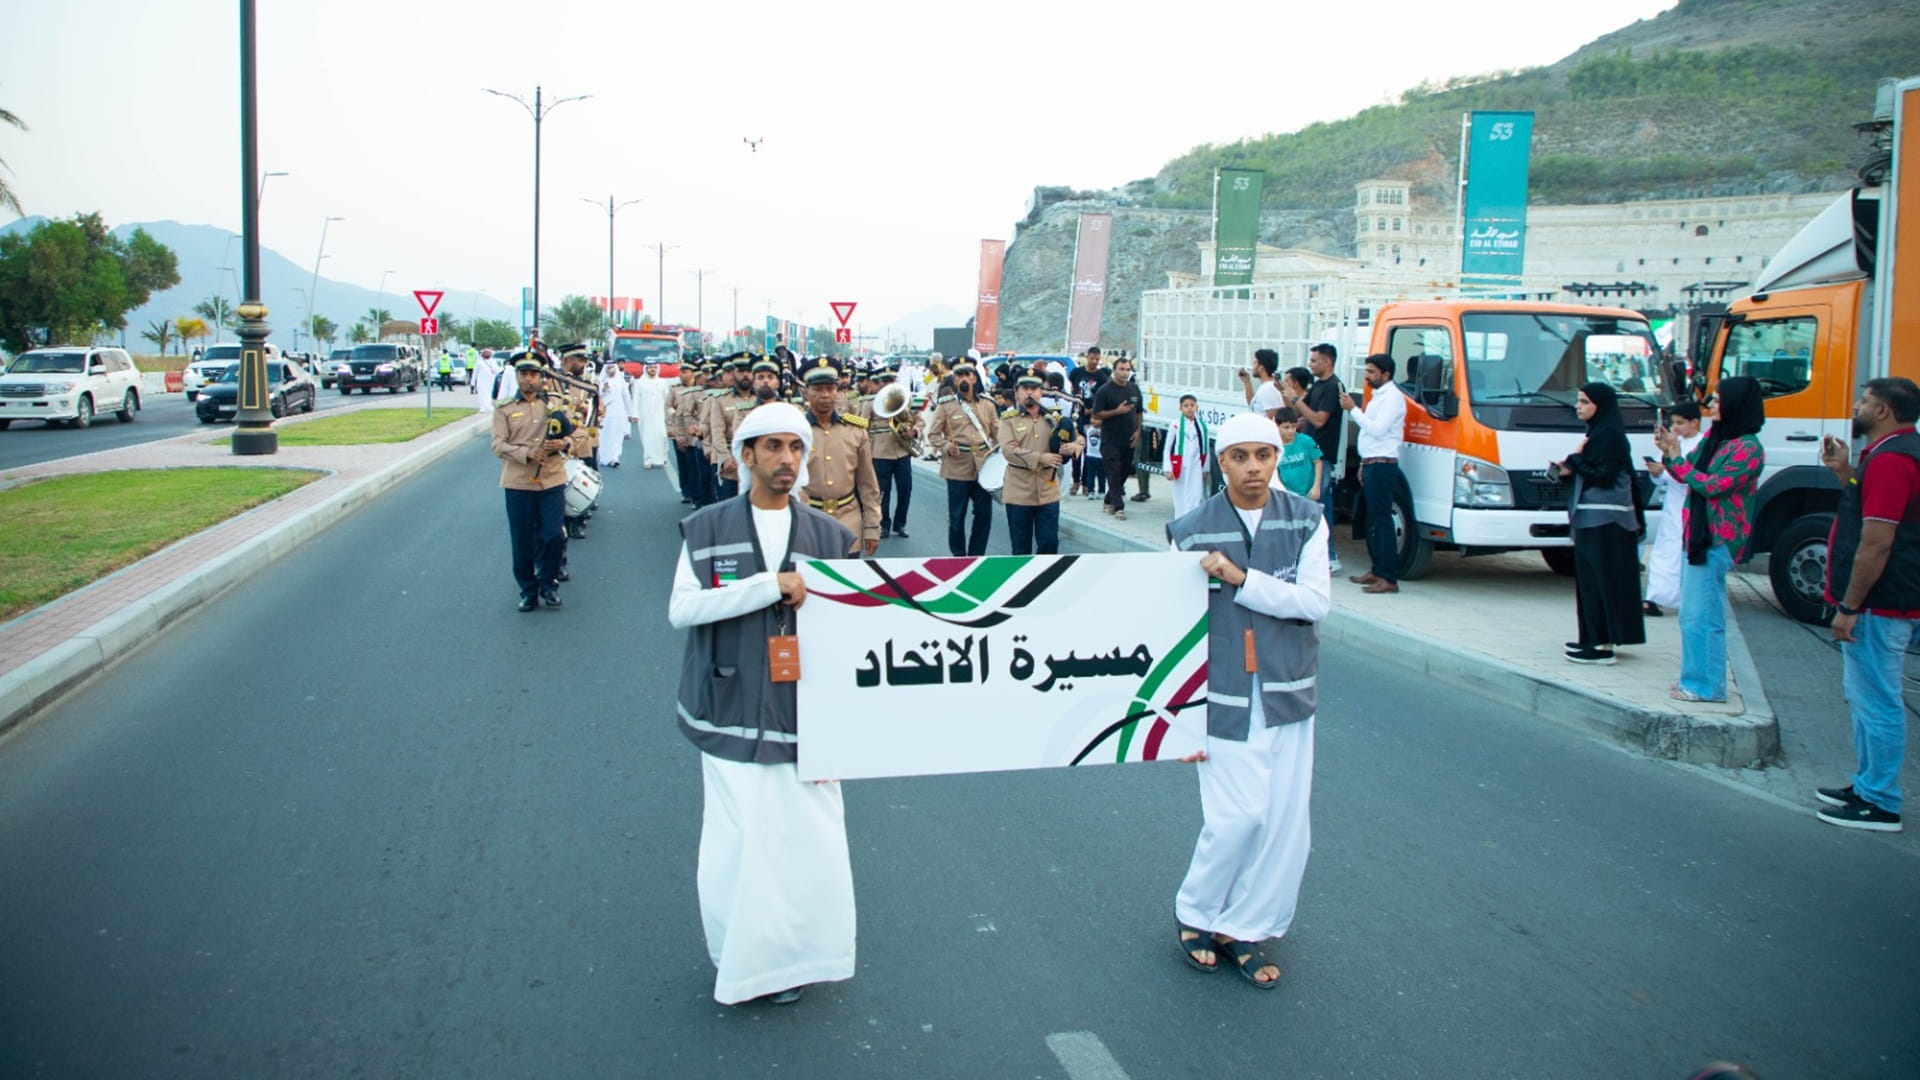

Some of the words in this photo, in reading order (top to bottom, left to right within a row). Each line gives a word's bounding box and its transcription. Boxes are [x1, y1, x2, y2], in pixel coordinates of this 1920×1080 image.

[1489, 122, 1514, 141] 53
[1233, 177, 1250, 190] 53
[855, 633, 989, 688] الاتحاد
[1009, 634, 1154, 692] مسيرة
